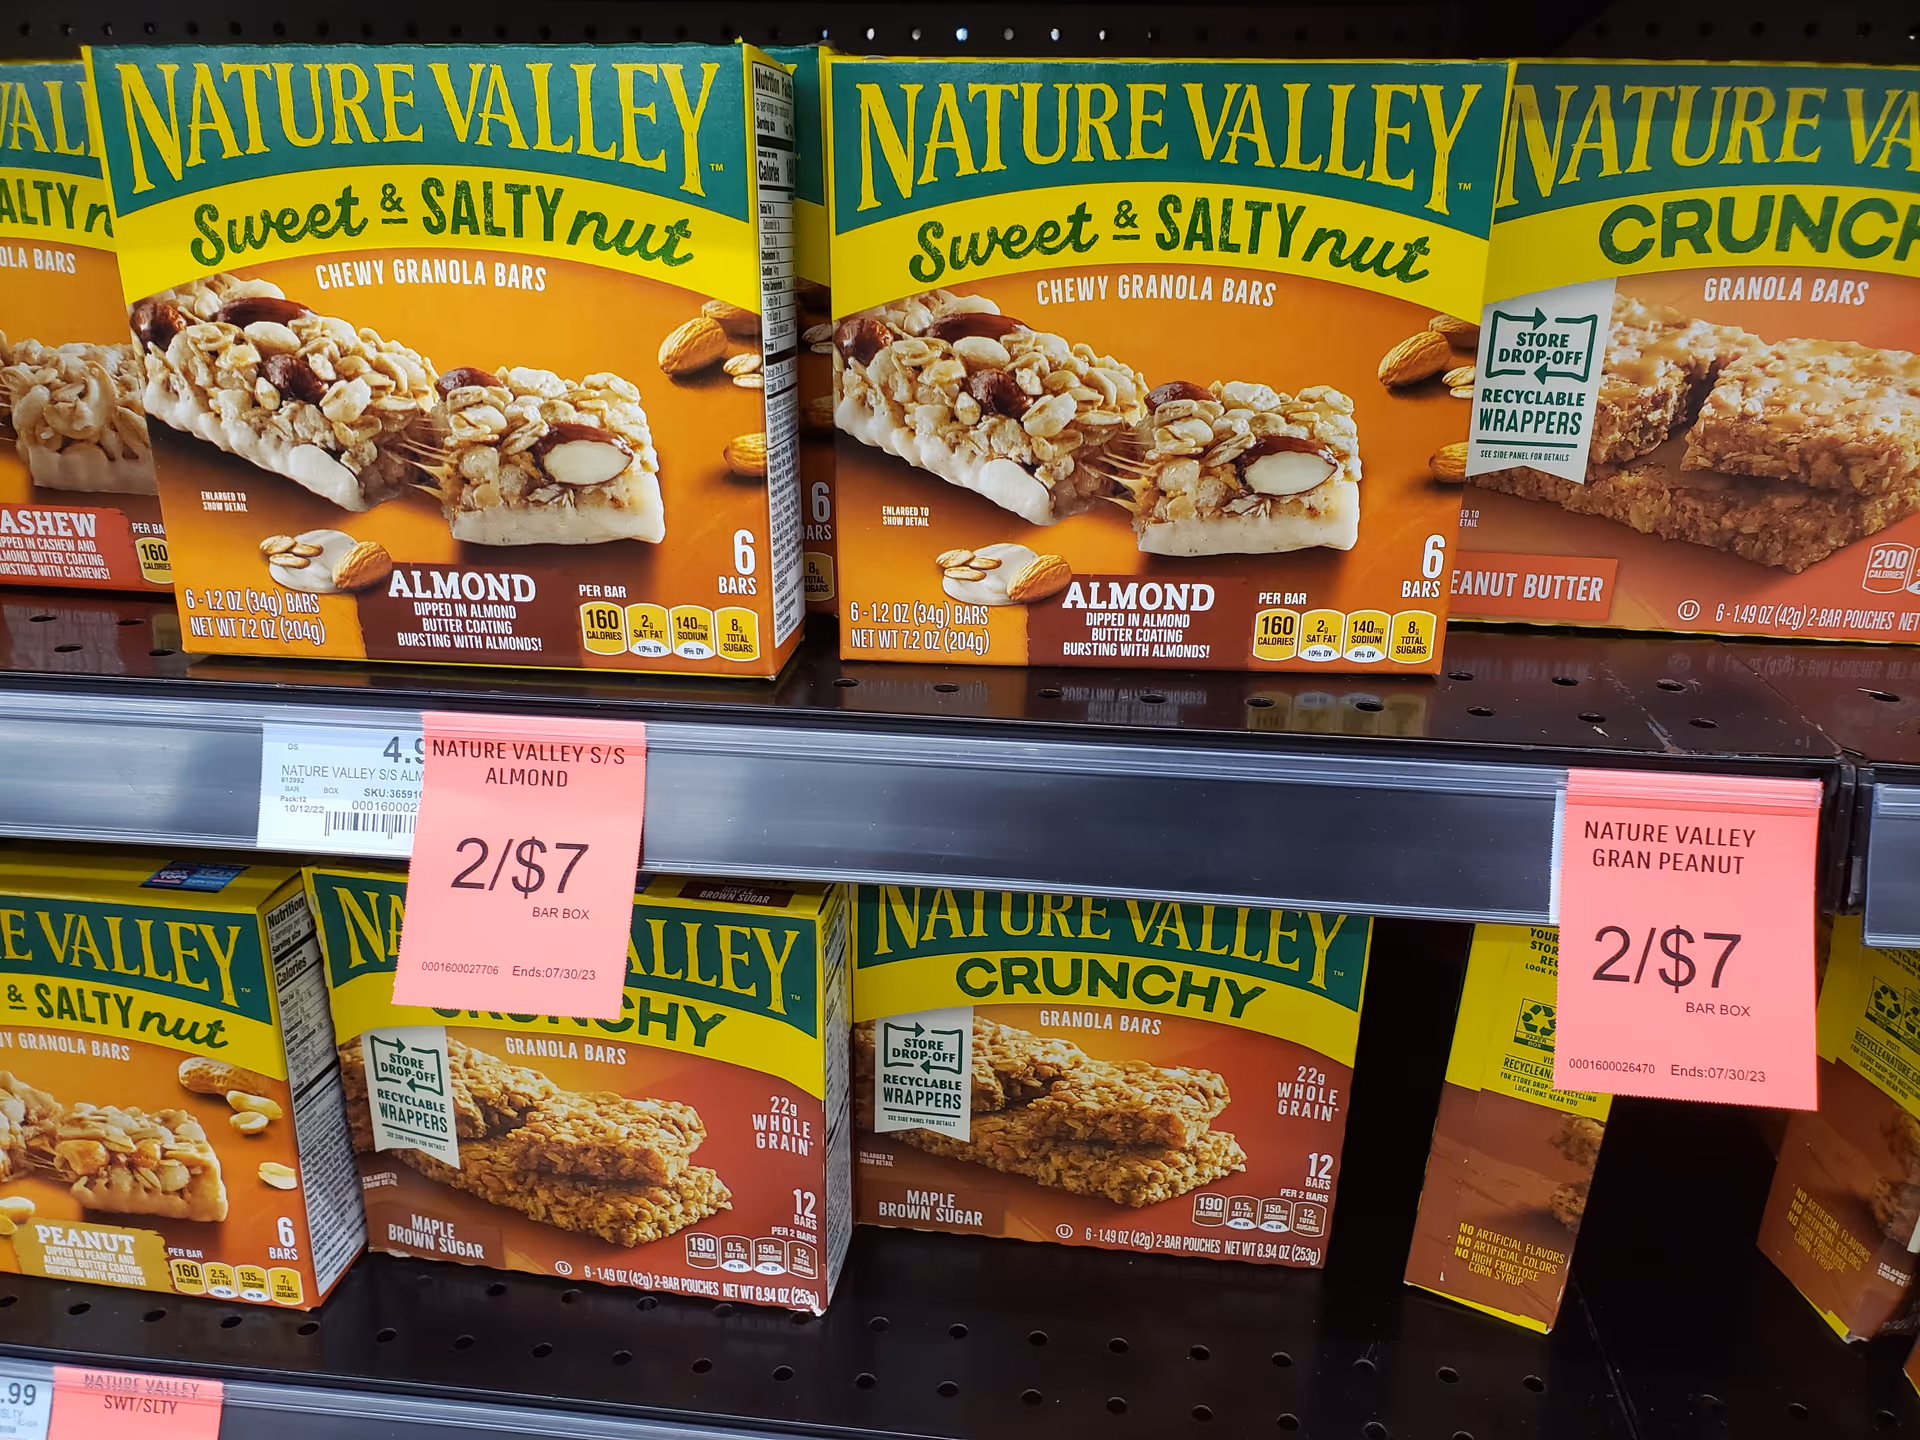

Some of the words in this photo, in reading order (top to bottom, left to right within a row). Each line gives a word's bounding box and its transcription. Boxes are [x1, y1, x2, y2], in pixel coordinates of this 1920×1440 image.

[115, 62, 424, 194] NATURE
[428, 62, 720, 197] VALLEY
[856, 82, 1169, 212] NATURE
[1181, 82, 1482, 216] VALLEY
[1495, 84, 1827, 208] NATURE
[190, 185, 368, 266] Sweet
[381, 183, 408, 217] &
[422, 177, 565, 242] SALTY
[566, 210, 694, 266] nut
[909, 201, 1099, 283] Sweet
[1113, 200, 1140, 234] &
[1155, 194, 1306, 259] SALTY
[1302, 227, 1430, 284] nut
[33, 248, 76, 274] BARS
[316, 259, 384, 290] CHEWY
[393, 258, 486, 287] GRANOLA
[495, 262, 546, 292] BARS
[1037, 275, 1108, 305] CHEWY
[1118, 273, 1213, 301] GRANOLA
[1222, 278, 1276, 307] BARS
[1704, 276, 1802, 302] GRANOLA
[1811, 278, 1869, 306] BARS
[1516, 332, 1570, 348] STORE
[1498, 348, 1583, 365] DROP-OFF
[1481, 388, 1586, 407] RECYCLABLE
[1479, 408, 1583, 436] WRAPPERS
[1480, 450, 1491, 458] SEE
[1493, 451, 1507, 459] SIDE
[1509, 451, 1528, 460] PANEL
[1530, 452, 1543, 460] FOR
[1544, 453, 1569, 461] DETAILS
[811, 481, 831, 523] 6
[882, 506, 918, 516] ENLARGED
[920, 506, 929, 516] TO
[882, 516, 903, 526] SHOW
[905, 517, 929, 527] DETAIL
[140, 544, 168, 561] 160
[733, 529, 755, 575] 6
[1422, 534, 1445, 579] 6
[1872, 549, 1909, 569] 200
[388, 570, 536, 602] ALMOND
[579, 584, 601, 597] PER
[604, 585, 626, 598] BAR
[718, 576, 756, 595] BARS
[1062, 582, 1215, 611] ALMOND
[1402, 580, 1440, 598] BARS
[1522, 573, 1604, 602] BUTTER
[185, 588, 195, 610] 6
[206, 589, 223, 611] 1.2
[227, 592, 242, 611] OZ
[247, 589, 283, 617] (34g)
[287, 593, 320, 614] BARS
[414, 601, 452, 616] DIPPED
[455, 603, 467, 617] IN
[470, 604, 516, 619] ALMOND
[422, 617, 463, 633] BUTTER
[466, 619, 512, 634] COATING
[586, 609, 619, 630] 160
[1261, 616, 1294, 635] 160
[1716, 603, 1724, 622] 6
[1733, 604, 1756, 624] 1.49
[1758, 605, 1773, 624] OZ
[1775, 604, 1806, 630] (42g)
[1807, 607, 1842, 627] 2-BAR
[1843, 608, 1894, 630] POUCHES
[1898, 612, 1920, 631] NET
[190, 616, 213, 638] NET
[216, 617, 236, 638] WT
[239, 619, 258, 639] 7.2
[261, 620, 278, 639] OZ
[280, 617, 325, 645] (204g)
[397, 632, 451, 648] BURSTING
[454, 634, 483, 649] WITH
[486, 636, 542, 651] ALMONDS!
[586, 631, 622, 641] CALORIES
[1257, 637, 1294, 646] CALORIES
[1351, 635, 1382, 644] SODIUM
[1401, 636, 1424, 645] TOTAL
[1063, 642, 1117, 656] BURSTING
[1120, 643, 1149, 657] WITH
[1152, 644, 1210, 659] ALMONDS!
[1395, 645, 1426, 654] SUGARS
[433, 739, 506, 759] NATURE
[512, 743, 584, 763] VALLEY
[590, 746, 625, 765] S/S
[281, 764, 329, 778] NATURE
[332, 767, 376, 780] VALLEY
[378, 768, 398, 781] S/S
[485, 767, 568, 787] ALMOND
[284, 804, 324, 814] 10/12/22
[1585, 821, 1669, 843] NATURE
[1675, 825, 1756, 848] VALLEY
[451, 836, 589, 899] 2/$7
[1592, 849, 1650, 870] GRAN
[1659, 852, 1744, 875] PEANUT
[532, 906, 558, 919] BAR
[563, 908, 590, 920] BOX
[1125, 900, 1348, 990] VALLEY
[34, 910, 241, 1008] VALLEY
[422, 961, 499, 975] 0001600027706
[512, 965, 596, 980] Ends:07/30/23
[1592, 924, 1742, 994] 2/$7
[956, 957, 1266, 1018] CRUNCHY
[34, 983, 133, 1029] SALTY
[139, 1010, 229, 1049] nut
[1040, 1010, 1113, 1030] GRANOLA
[1120, 1015, 1161, 1035] BARS
[1686, 1002, 1715, 1015] BAR
[1720, 1004, 1750, 1017] BOX
[18, 1032, 86, 1055] GRANOLA
[91, 1040, 130, 1061] BARS
[1569, 1058, 1655, 1075] 0001600026470
[1671, 1064, 1766, 1083] Ends:07/30/23
[377, 1088, 446, 1114] RECYCLABLE
[770, 1096, 797, 1117] 22g
[378, 1102, 448, 1133] WRAPPERS
[752, 1113, 811, 1139] WHOLE
[1308, 1153, 1334, 1179] 12
[1305, 1176, 1331, 1190] BARS
[793, 1189, 817, 1219] 12
[277, 1217, 295, 1247] 6
[411, 1213, 455, 1239] MAPLE
[1796, 1186, 1807, 1203] NO
[1806, 1198, 1840, 1235] ARTIFICIAL
[1840, 1229, 1871, 1263] FLAVORS
[35, 1224, 134, 1254] PEANUT
[388, 1223, 435, 1250] BROWN
[439, 1236, 484, 1259] SUGAR
[1183, 1236, 1221, 1254] POUCHES
[1459, 1222, 1474, 1236] NO
[1476, 1228, 1522, 1251] ARTIFICIAL
[1525, 1243, 1565, 1264] FLAVORS
[268, 1247, 298, 1260] BARS
[1454, 1246, 1469, 1259] NO
[1471, 1252, 1492, 1268] HIGH
[1494, 1259, 1539, 1282] FRUCTOSE
[1456, 1234, 1471, 1247] NO
[1473, 1240, 1519, 1263] ARTIFICIAL
[1522, 1255, 1557, 1275] COLORS
[1468, 1261, 1492, 1277] CORN
[1494, 1270, 1523, 1286] SYRUP
[104, 1395, 178, 1415] SWT/SLTY
